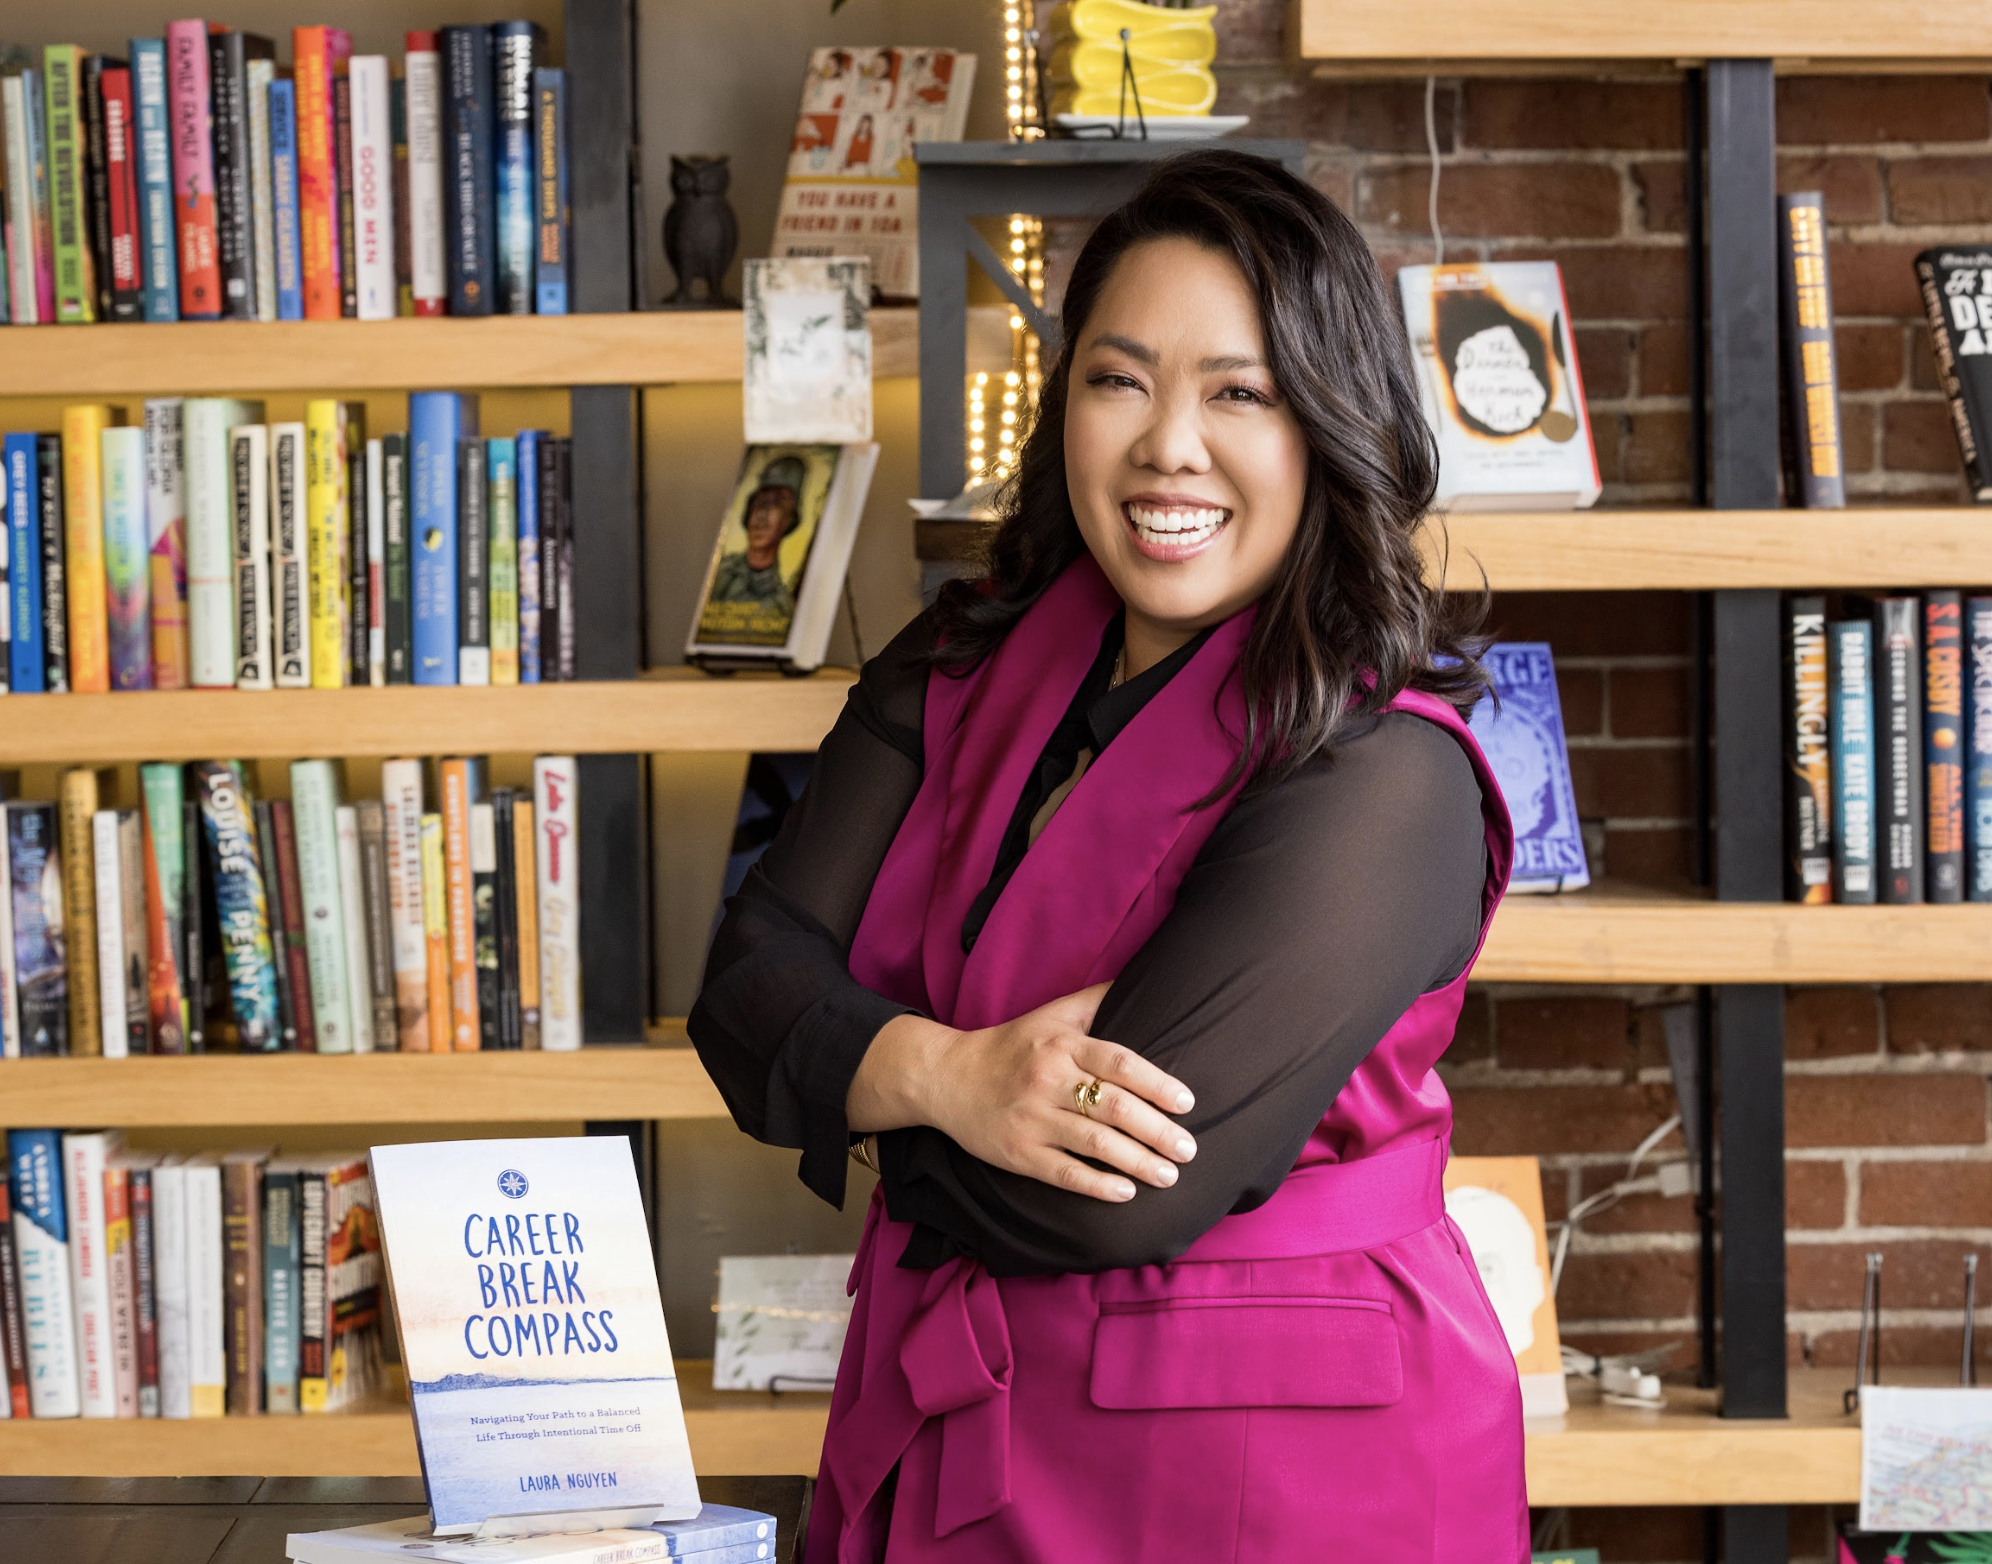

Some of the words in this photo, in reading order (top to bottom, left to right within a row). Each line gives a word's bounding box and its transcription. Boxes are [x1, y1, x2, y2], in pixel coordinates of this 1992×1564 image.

[176, 37, 194, 94] FAMILY
[542, 91, 554, 101] A
[180, 102, 198, 159] FAMILY
[542, 105, 555, 177] THOUSAND
[54, 148, 75, 245] REVOLUTION
[360, 146, 375, 210] GOOD
[543, 181, 556, 219] SHIPS
[797, 191, 828, 207] YOU
[835, 191, 877, 207] HAVE
[883, 191, 896, 207] A
[362, 219, 377, 264] MEN
[781, 215, 838, 232] FRIEND
[845, 216, 861, 231] IN
[1463, 346, 1524, 370] Dinner
[12, 451, 27, 488] GREY
[14, 490, 28, 528] BEES
[542, 537, 555, 609] Atonement
[1928, 603, 1960, 622] S.
[1928, 626, 1960, 645] A.
[1492, 654, 1549, 685] RGE
[1841, 632, 1865, 694] RABBIT
[1891, 633, 1906, 701] BECOMING
[1929, 647, 1960, 715] COSBY
[1794, 614, 1826, 766] KILLINGLY
[1843, 699, 1866, 743] HOLE
[1893, 707, 1906, 731] THE
[1844, 754, 1867, 797] KATE
[1892, 737, 1908, 816] BOOGEYMAN
[1845, 800, 1869, 859] BRODY
[1515, 840, 1579, 871] DERS
[209, 773, 245, 874] LOUISE
[228, 910, 261, 1002] PENNY
[452, 887, 466, 962] PARADISE
[33, 1144, 50, 1218] ANDREA
[304, 1181, 324, 1266] LOVECRAFT
[465, 1212, 584, 1258] CAREER
[274, 1269, 290, 1328] NATIVE
[304, 1268, 324, 1339] COUNTRY
[478, 1260, 585, 1308] BREAK
[22, 1249, 47, 1379] REBELS
[465, 1310, 618, 1359] COMPASS
[275, 1336, 290, 1368] SON
[470, 1413, 525, 1426] Navigating
[527, 1411, 550, 1422] Your
[553, 1409, 574, 1419] Path
[576, 1409, 586, 1418] to
[597, 1406, 640, 1418] Balanced
[477, 1432, 496, 1443] Life
[498, 1429, 540, 1443] Through
[542, 1426, 598, 1437] Intentional
[600, 1425, 624, 1434] Time
[626, 1422, 642, 1433] Off
[520, 1474, 560, 1493] LAURA
[568, 1471, 617, 1488] NGUYEN
[594, 1551, 614, 1564] CAREER
[616, 1547, 633, 1561] BREAK
[635, 1544, 660, 1559] COMPASS
